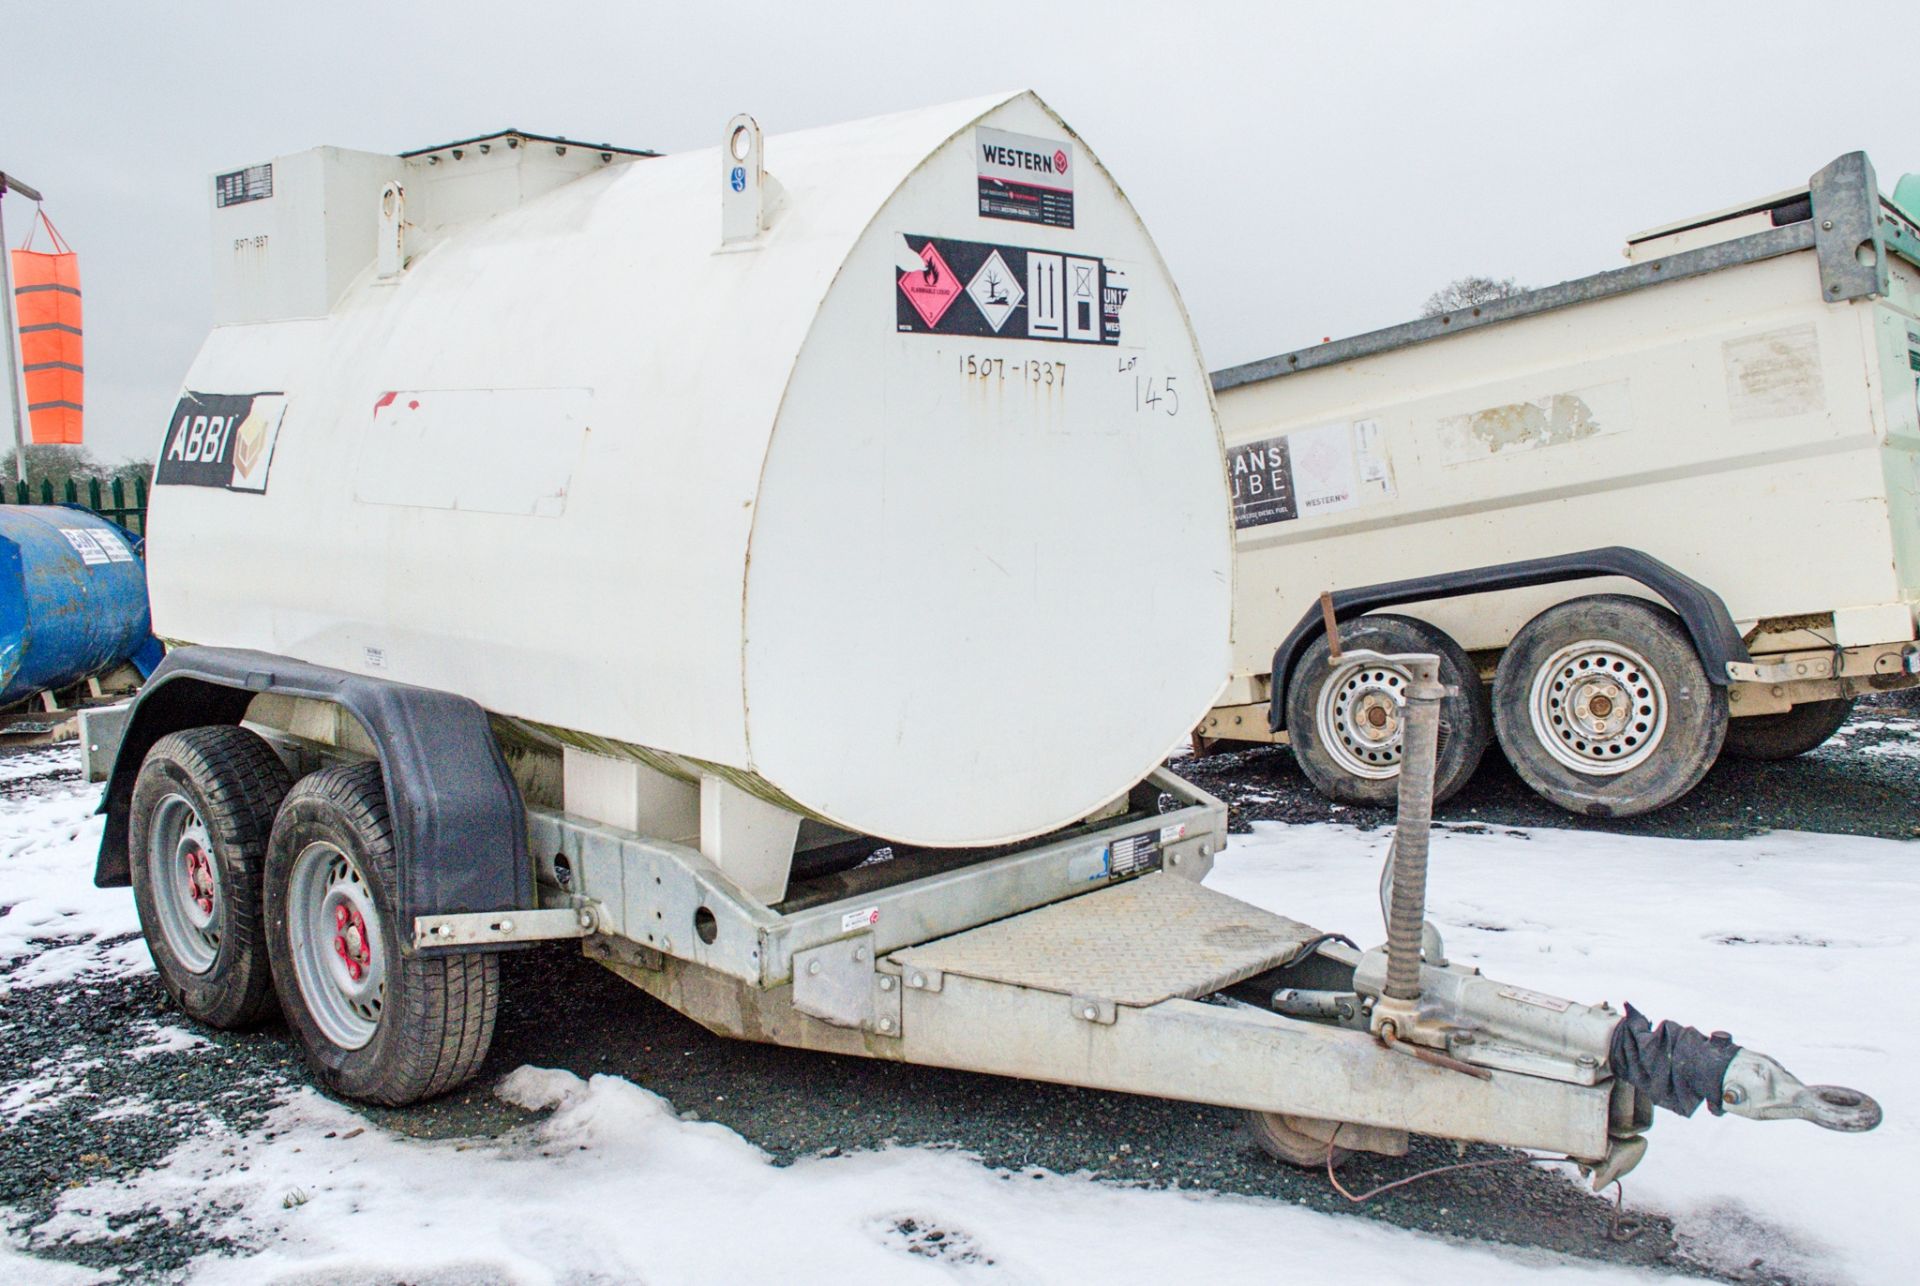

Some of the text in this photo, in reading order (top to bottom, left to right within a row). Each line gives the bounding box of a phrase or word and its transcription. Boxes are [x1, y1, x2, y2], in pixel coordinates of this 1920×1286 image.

[982, 143, 1052, 174] WESTERN
[1135, 374, 1179, 416] 145
[167, 415, 235, 464] ABBI
[1305, 494, 1342, 508] WESTERN
